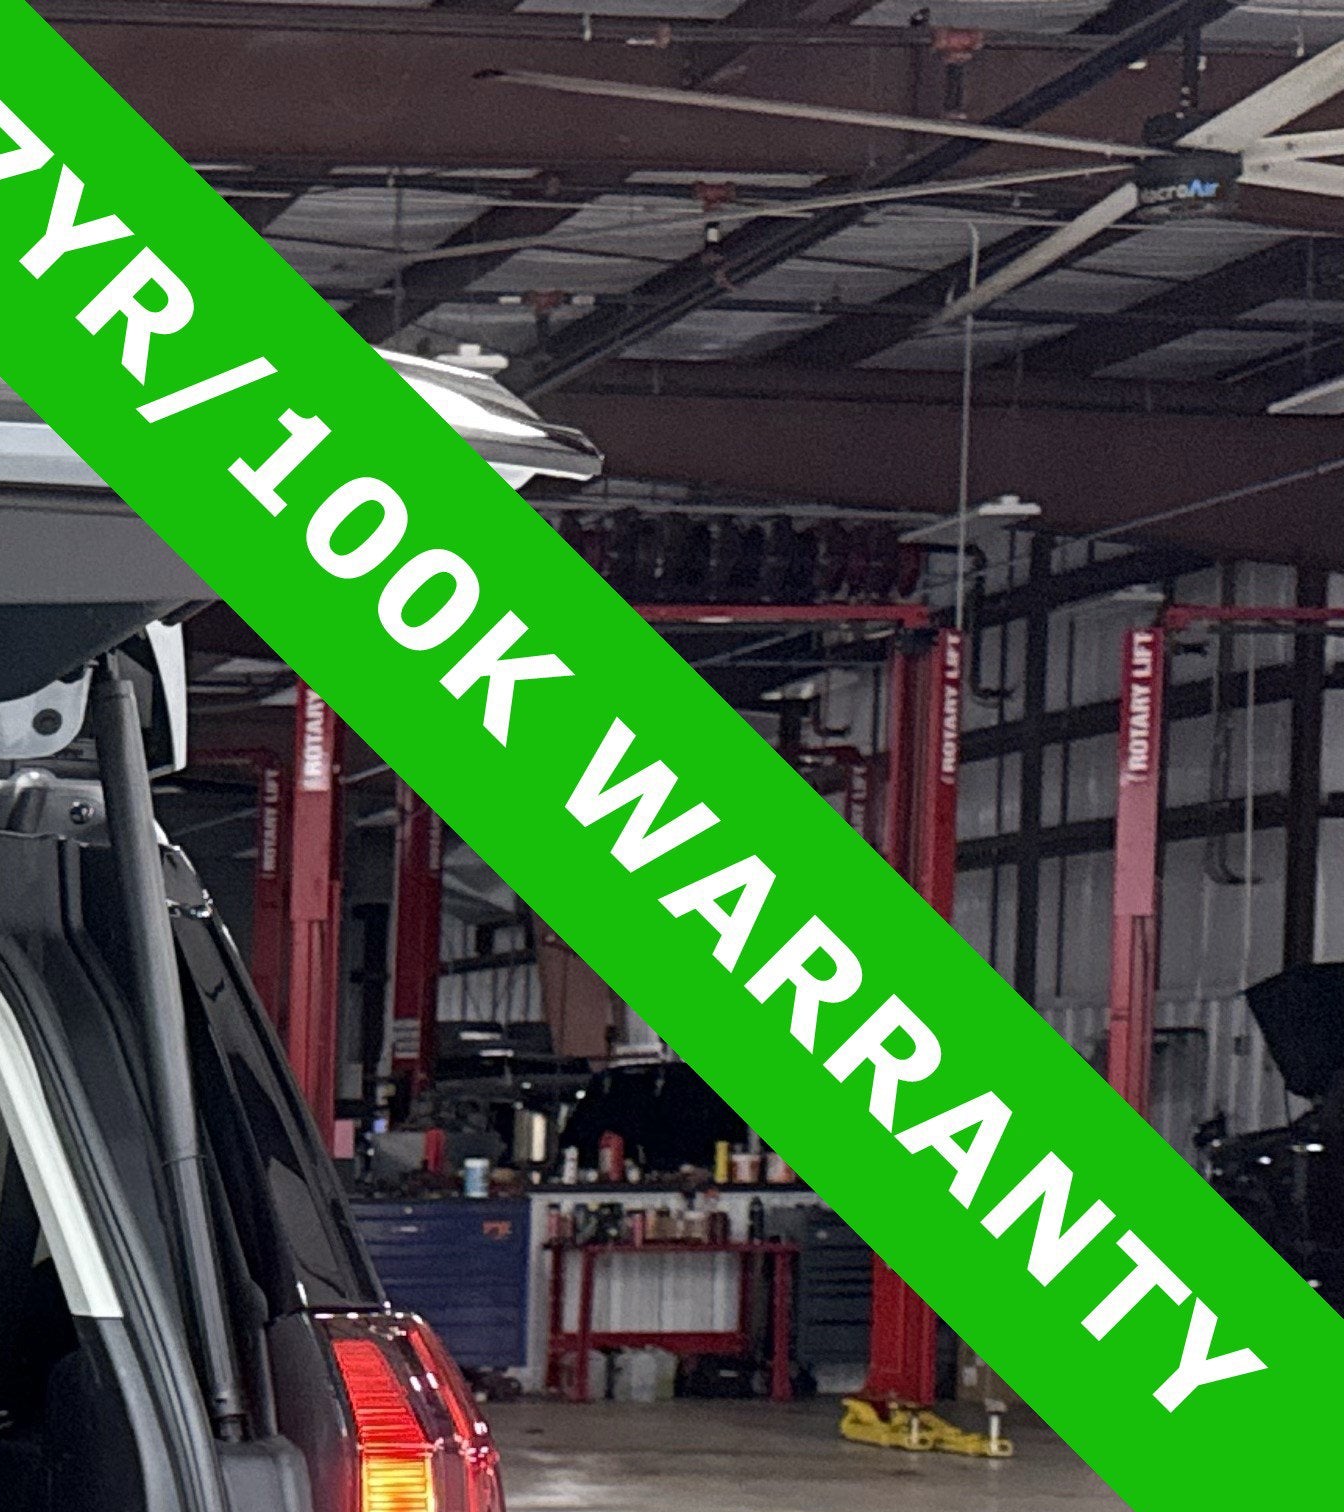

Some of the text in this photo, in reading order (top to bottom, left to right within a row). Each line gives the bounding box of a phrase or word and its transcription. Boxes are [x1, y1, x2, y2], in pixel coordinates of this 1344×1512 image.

[304, 688, 326, 779] ROTARY
[941, 632, 961, 773] ROTARY LIFT
[1128, 632, 1154, 772] ROTARY LIFT
